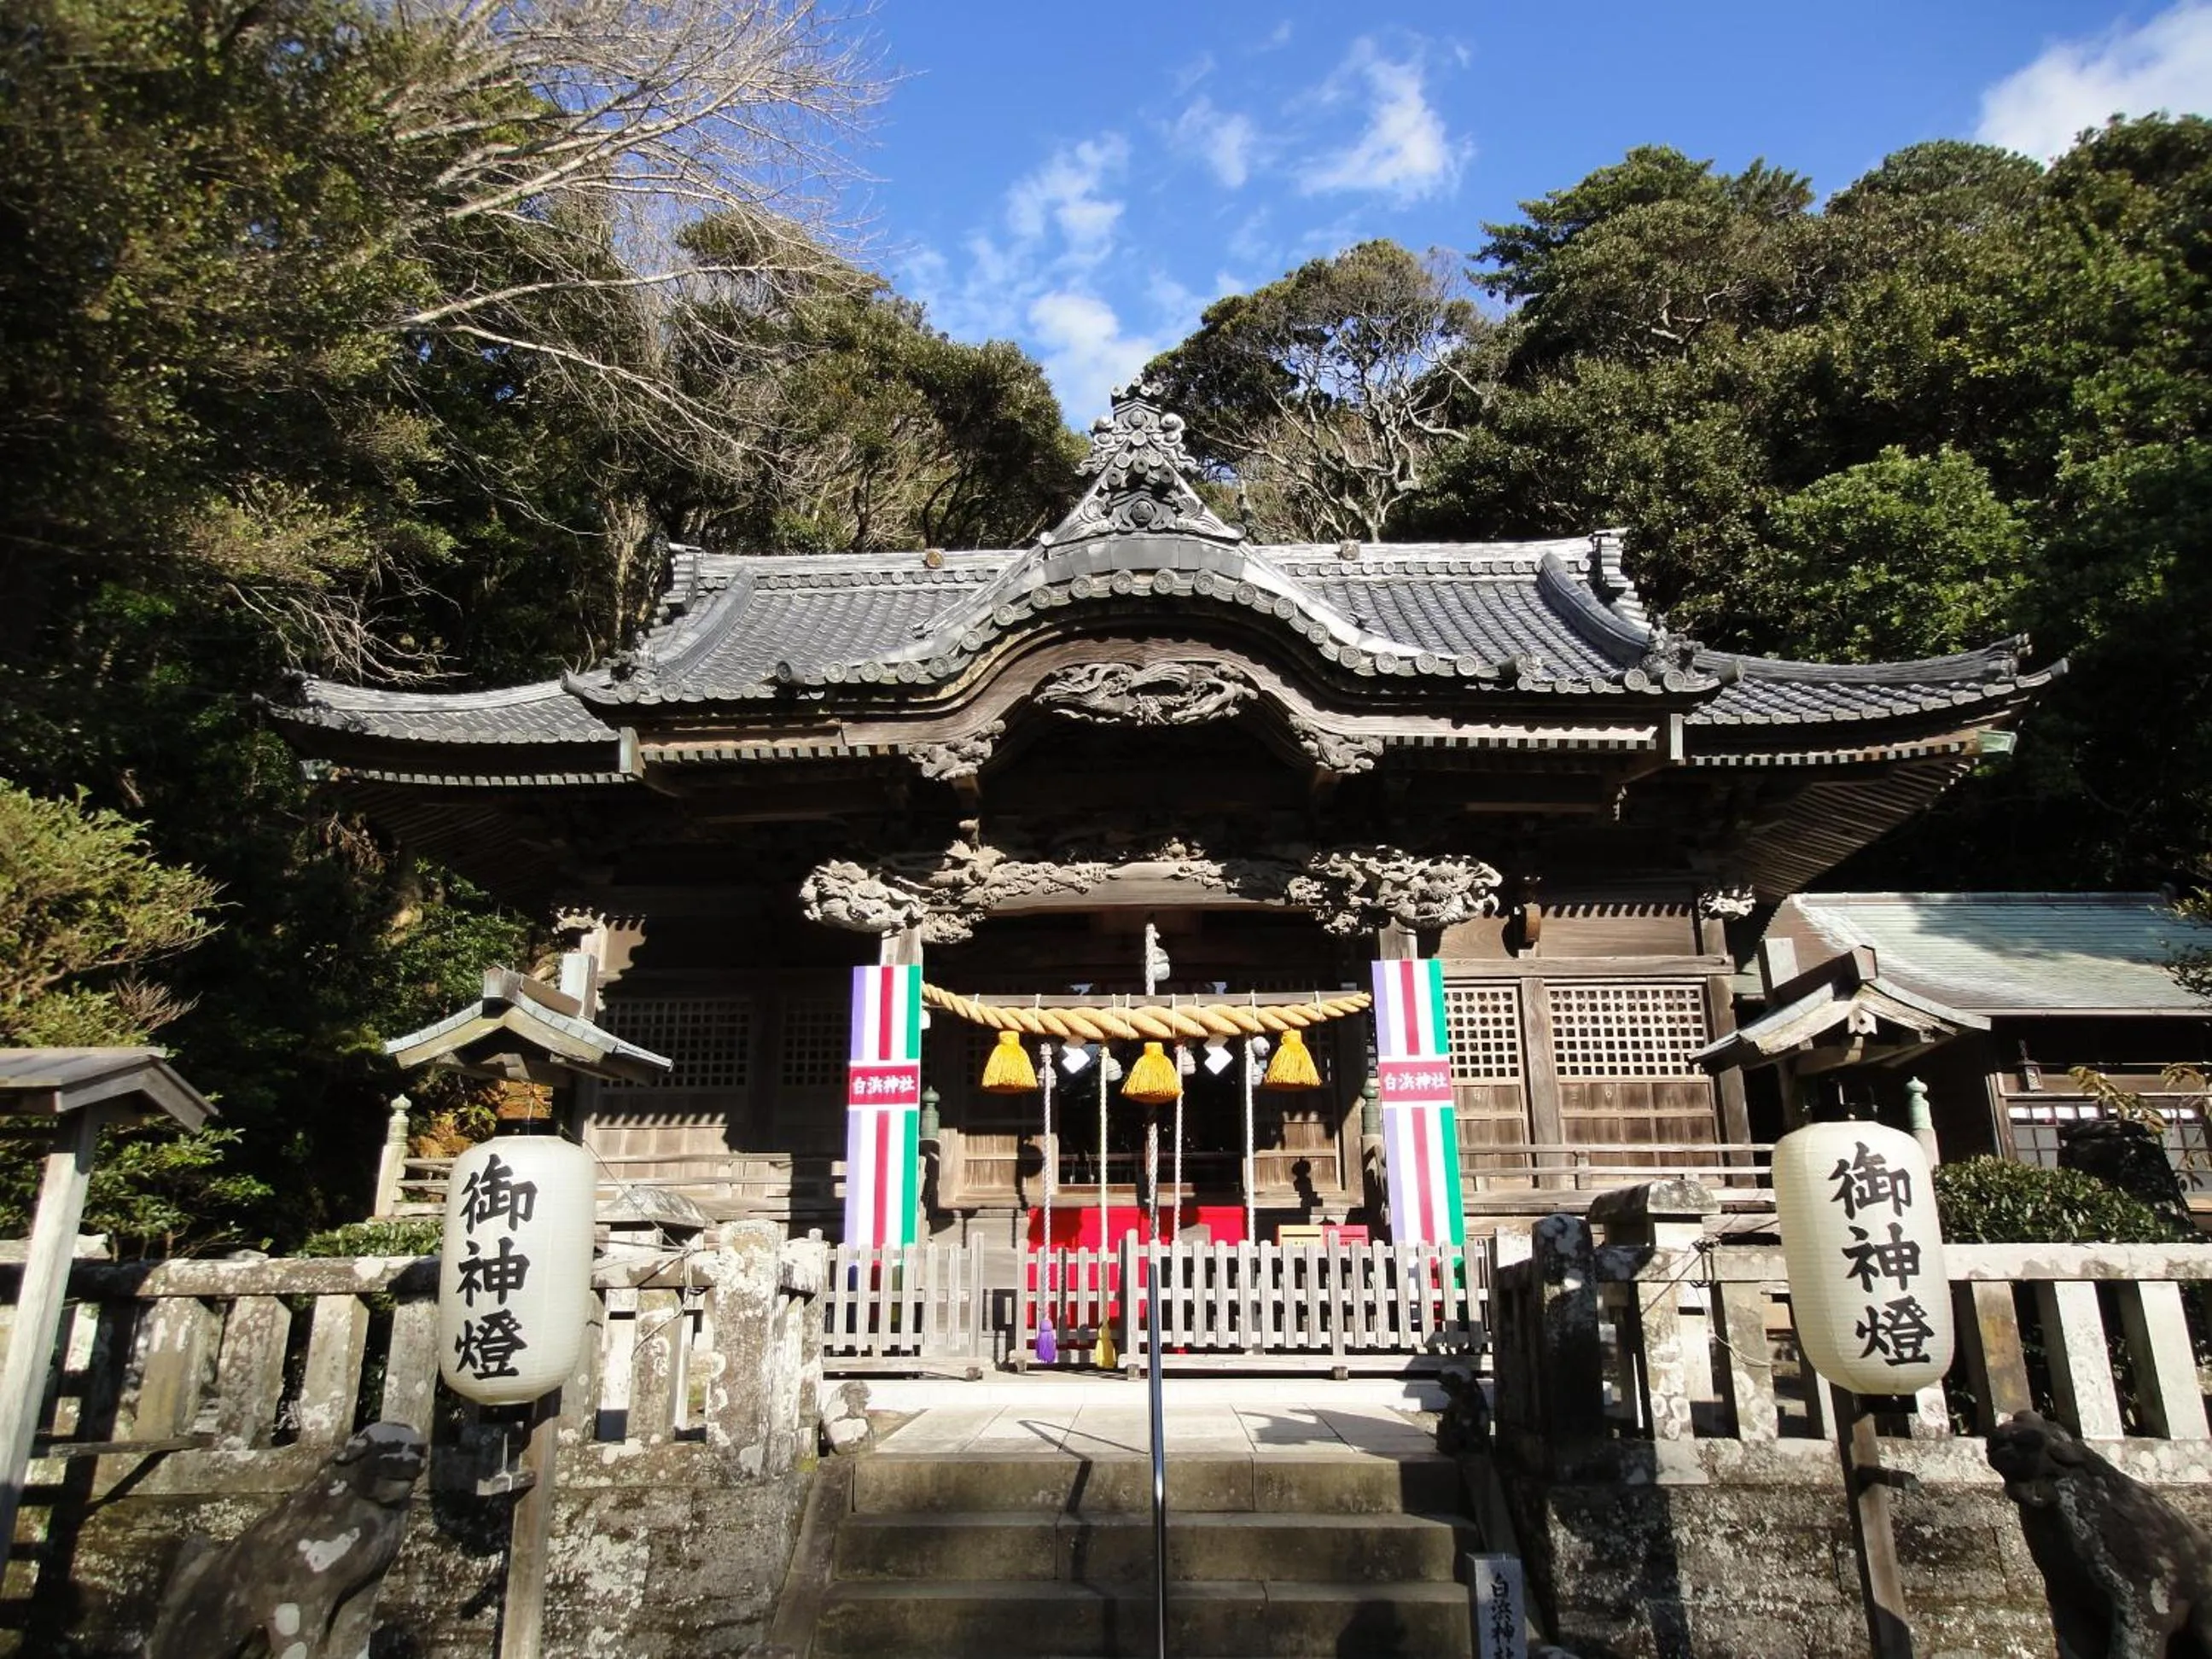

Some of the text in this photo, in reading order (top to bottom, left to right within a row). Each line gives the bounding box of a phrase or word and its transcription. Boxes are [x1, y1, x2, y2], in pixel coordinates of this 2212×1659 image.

[854, 1075, 915, 1095] 白浜神社
[1384, 1072, 1447, 1091] 白浜神社
[454, 1153, 538, 1381] 御神燈
[1828, 1141, 1936, 1366] 御神燈
